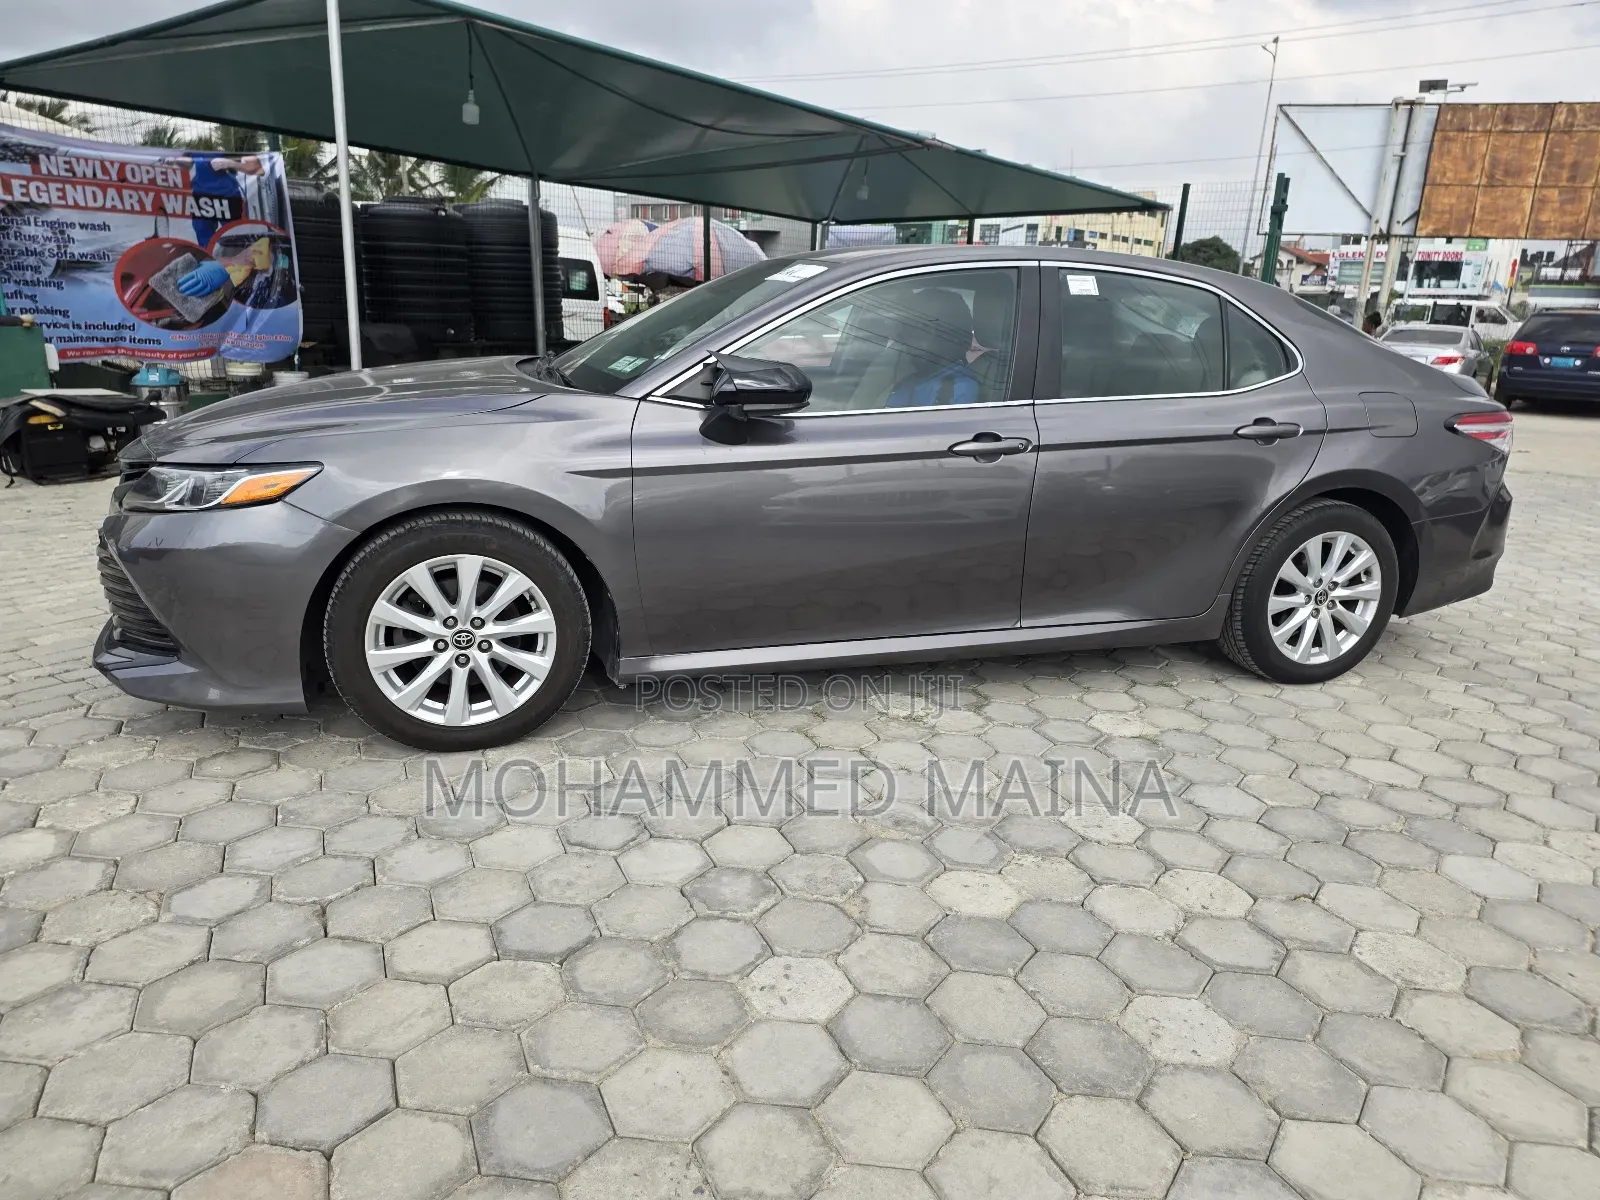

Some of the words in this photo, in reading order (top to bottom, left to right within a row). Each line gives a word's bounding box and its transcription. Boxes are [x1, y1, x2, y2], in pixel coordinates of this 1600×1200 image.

[38, 153, 120, 182] NEWLY
[125, 163, 184, 189] OPEN
[0, 177, 155, 213] LEGENDARY
[160, 192, 231, 219] WASH
[33, 216, 76, 231] Engine
[78, 221, 111, 232] wash
[14, 231, 40, 244] Rug
[42, 233, 75, 245] wash
[47, 248, 76, 260] Sofa
[77, 251, 110, 261] wash
[1417, 251, 1441, 262] TRINITY
[1442, 251, 1464, 262] DOORS
[13, 276, 65, 290] washing
[72, 320, 82, 330] is
[84, 321, 136, 332] included
[56, 333, 127, 345] maintenance
[128, 335, 162, 346] items
[117, 347, 132, 355] the
[134, 350, 165, 360] beauty
[167, 352, 177, 360] of
[178, 351, 196, 361] your
